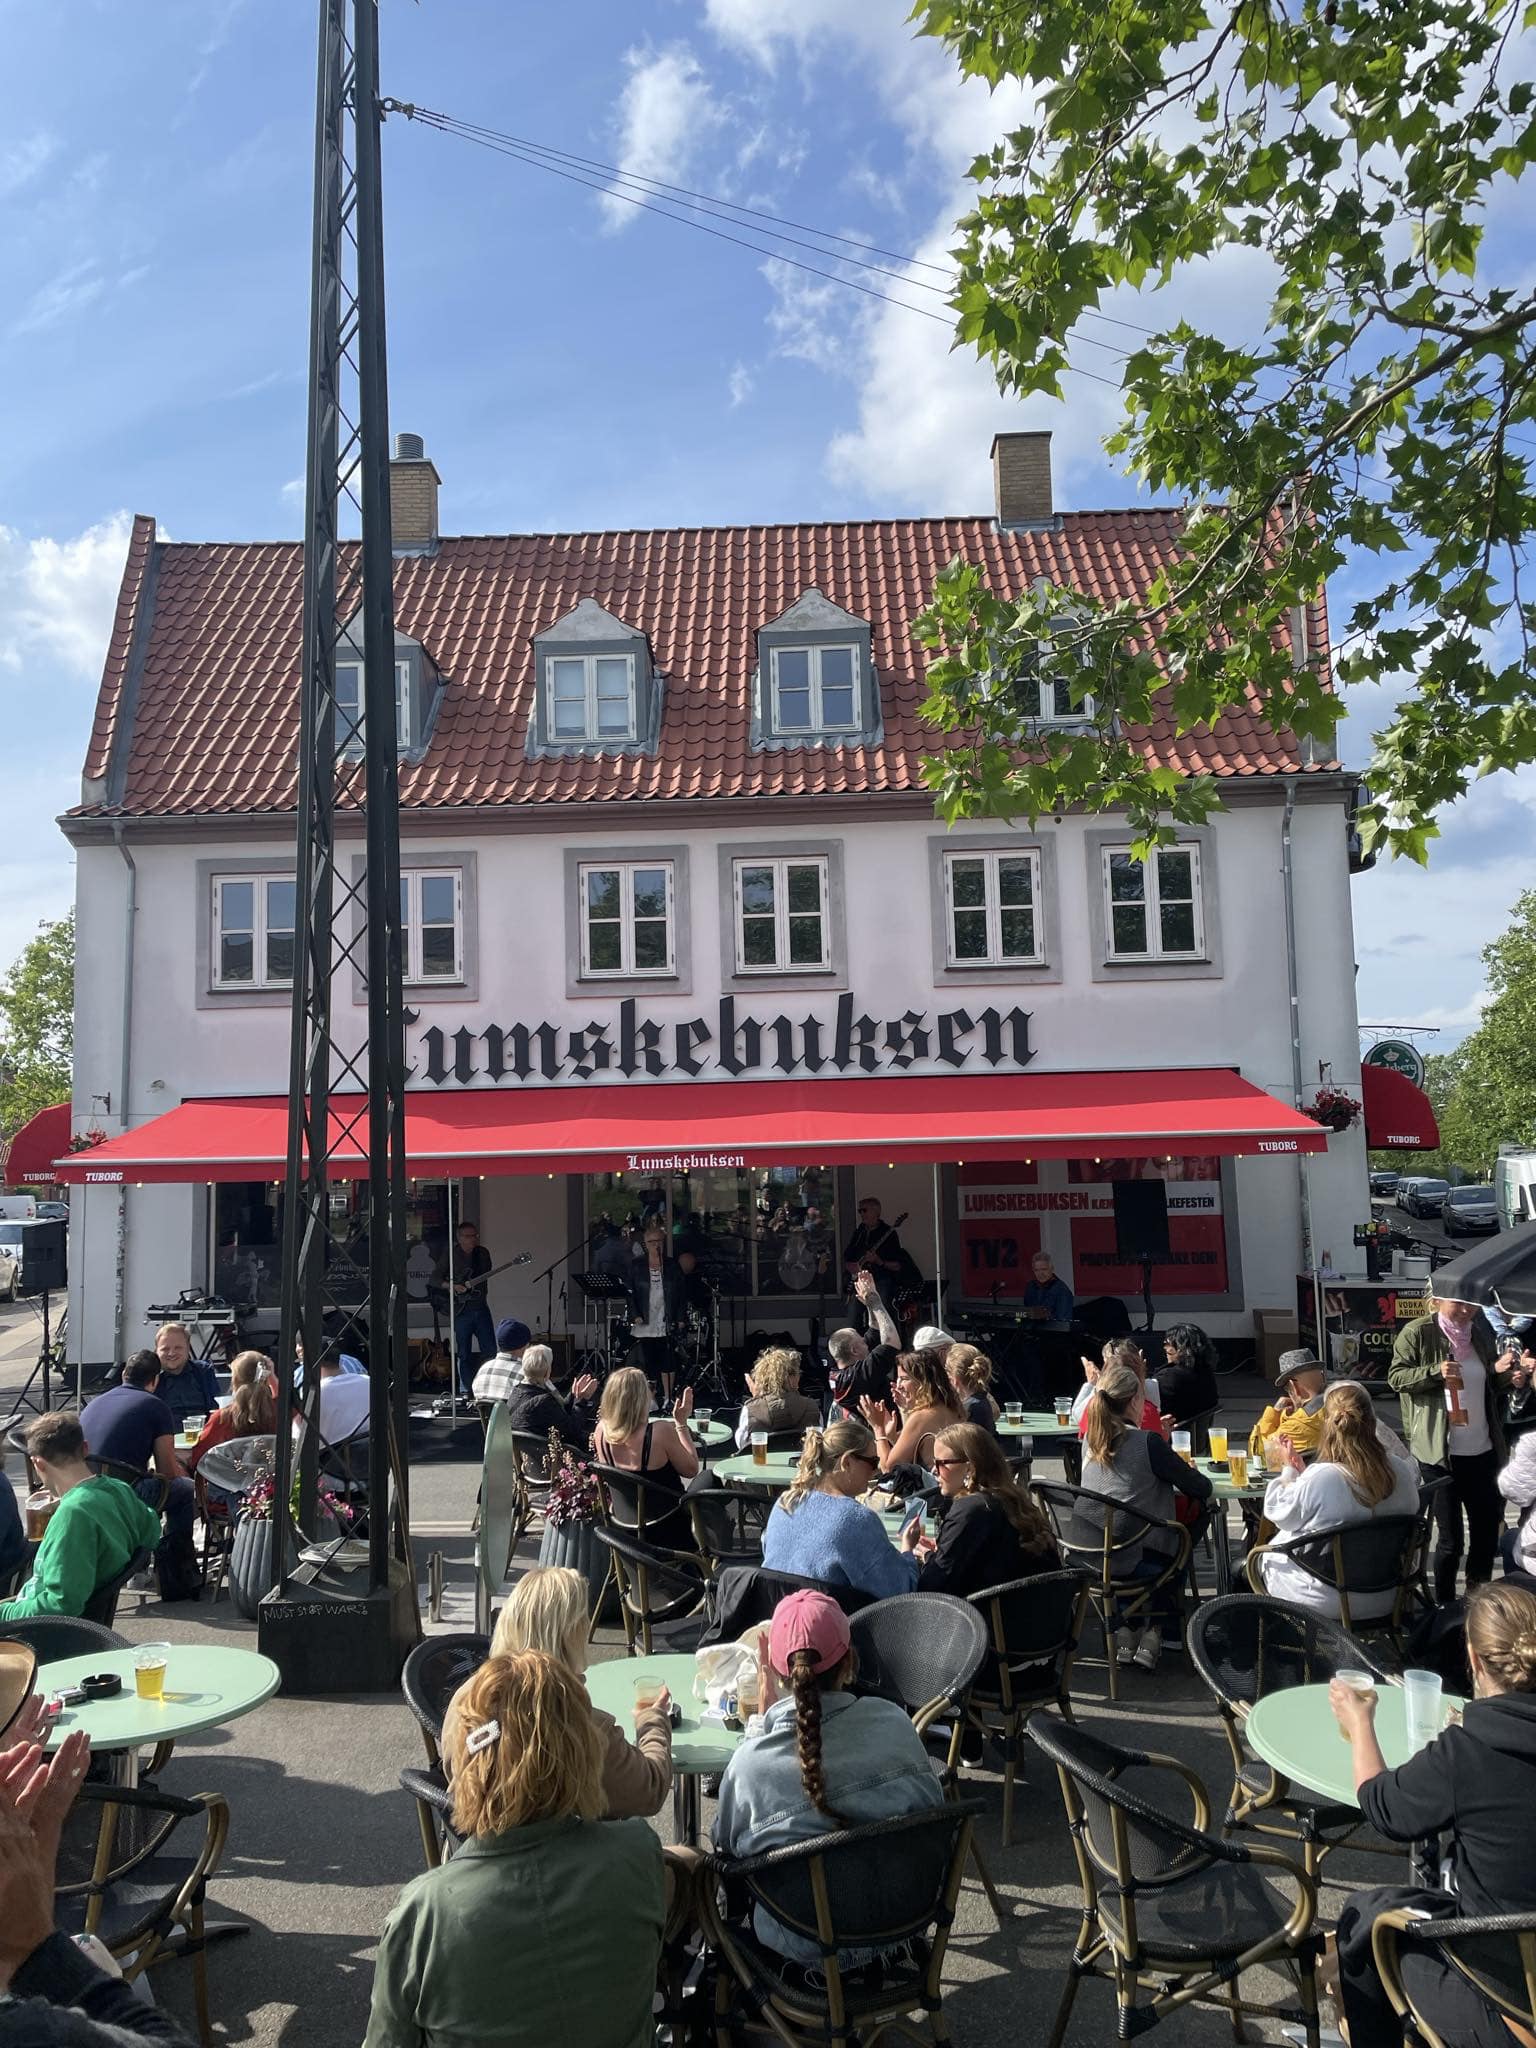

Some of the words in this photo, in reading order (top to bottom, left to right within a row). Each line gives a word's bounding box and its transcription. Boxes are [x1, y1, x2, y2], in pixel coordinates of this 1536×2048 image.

[1387, 1136, 1420, 1144] TUBORG
[1258, 1141, 1297, 1151] TUBORG
[627, 1154, 745, 1170] Lumskebuksen
[23, 1173, 56, 1181] TUBORG
[86, 1172, 123, 1181] TUBORG
[965, 1192, 1089, 1212] LUMSKEBUKSEN
[966, 1239, 1018, 1267] TV2
[1398, 1301, 1423, 1309] VODKA
[264, 1606, 294, 1623] MUST
